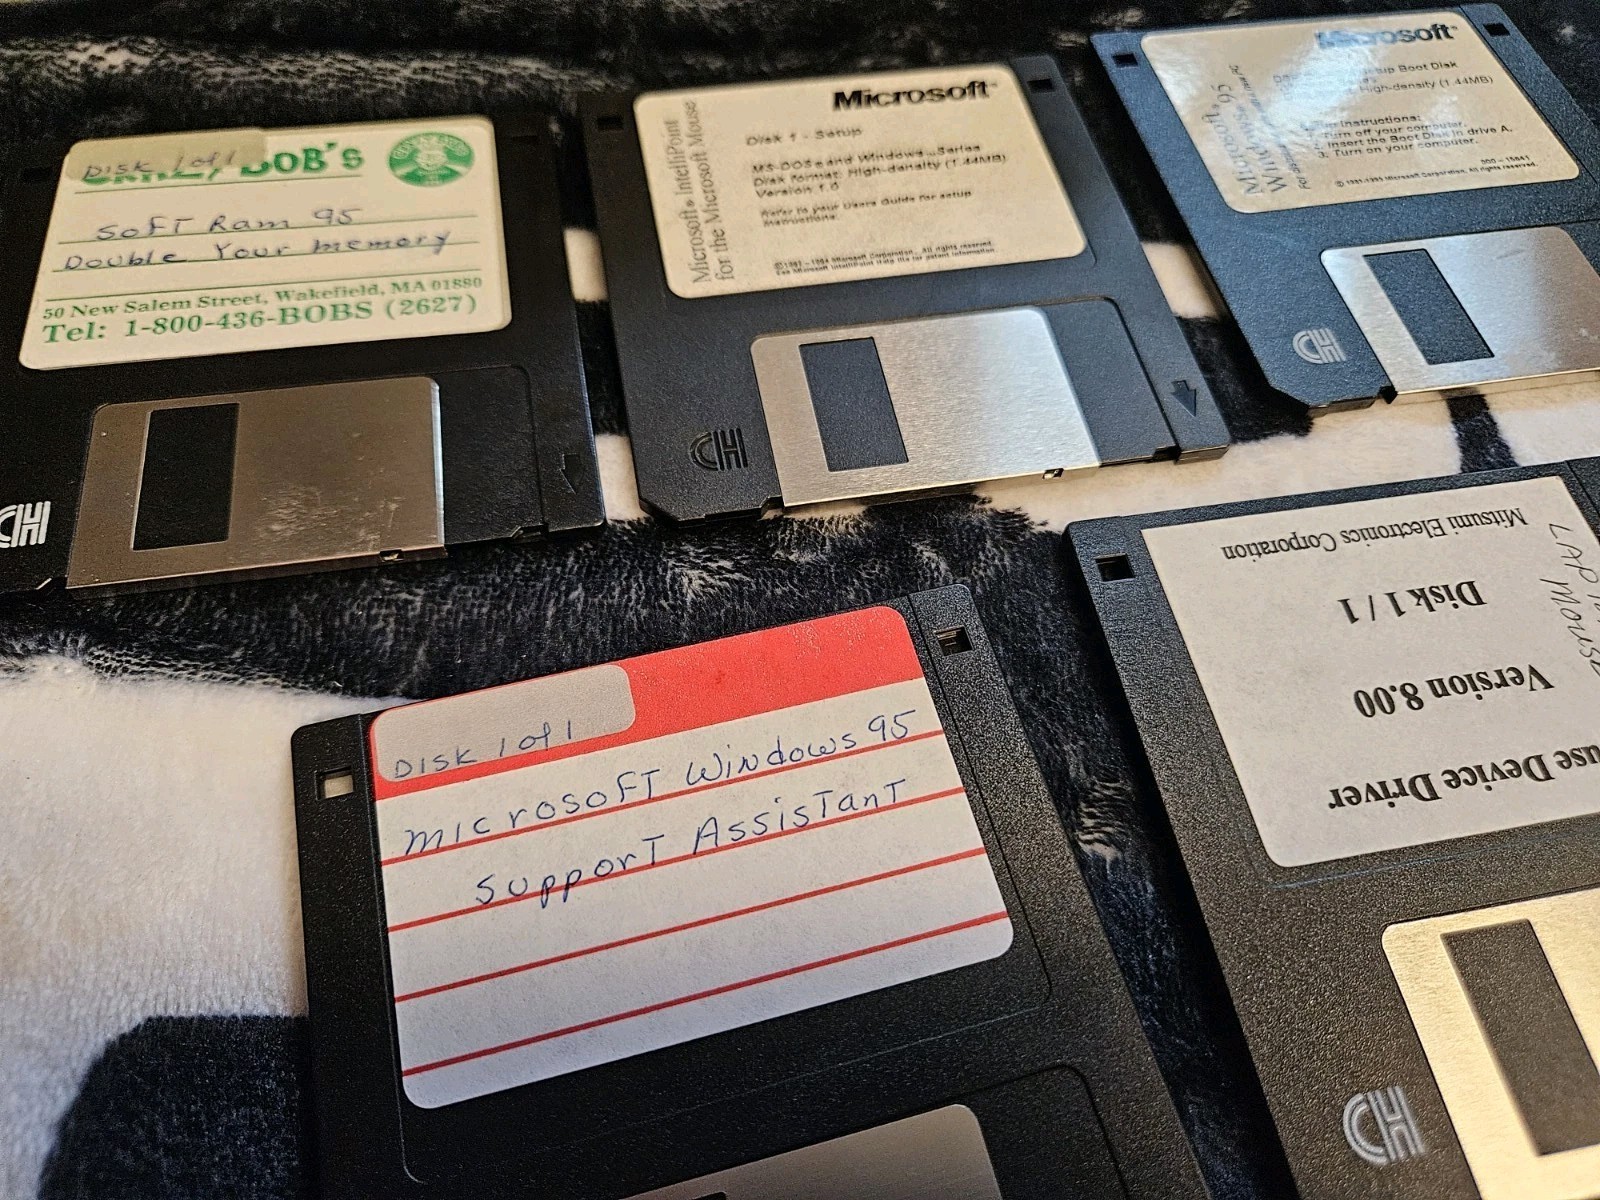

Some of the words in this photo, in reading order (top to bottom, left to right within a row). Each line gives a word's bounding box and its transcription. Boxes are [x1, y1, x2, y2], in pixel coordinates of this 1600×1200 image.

[1315, 23, 1454, 48] rosoft
[1398, 63, 1428, 73] Boot
[1430, 61, 1458, 70] Disk
[833, 80, 990, 112] Microsoft
[1355, 128, 1371, 137] off
[1375, 127, 1402, 136] your
[1367, 137, 1386, 145] the
[1390, 134, 1419, 143] Boot
[1467, 127, 1496, 136] drive
[1334, 149, 1362, 157] Turn
[1386, 144, 1413, 154] your
[689, 151, 722, 224] Microsoft
[313, 208, 363, 225] 95
[709, 228, 729, 253] the
[714, 256, 735, 280] for
[42, 307, 65, 320] 50
[70, 304, 118, 318] New
[124, 299, 192, 314] Salem
[390, 281, 426, 295] MA
[432, 276, 482, 291] 01880
[42, 321, 107, 343] Tel:
[125, 300, 373, 337] 1-800-436-BOBS
[386, 294, 477, 320] (2627)
[1340, 517, 1448, 547] Electronics
[1447, 507, 1529, 536] Mitsumi
[1221, 531, 1338, 562] Corporation
[1337, 598, 1360, 625] 1
[1385, 591, 1406, 618] 1
[1406, 580, 1488, 613] Disk
[1426, 664, 1555, 701] Version
[1353, 682, 1425, 718] 8.00
[868, 709, 917, 742] 95
[1440, 753, 1556, 792] Device
[1328, 772, 1443, 809] Driver
